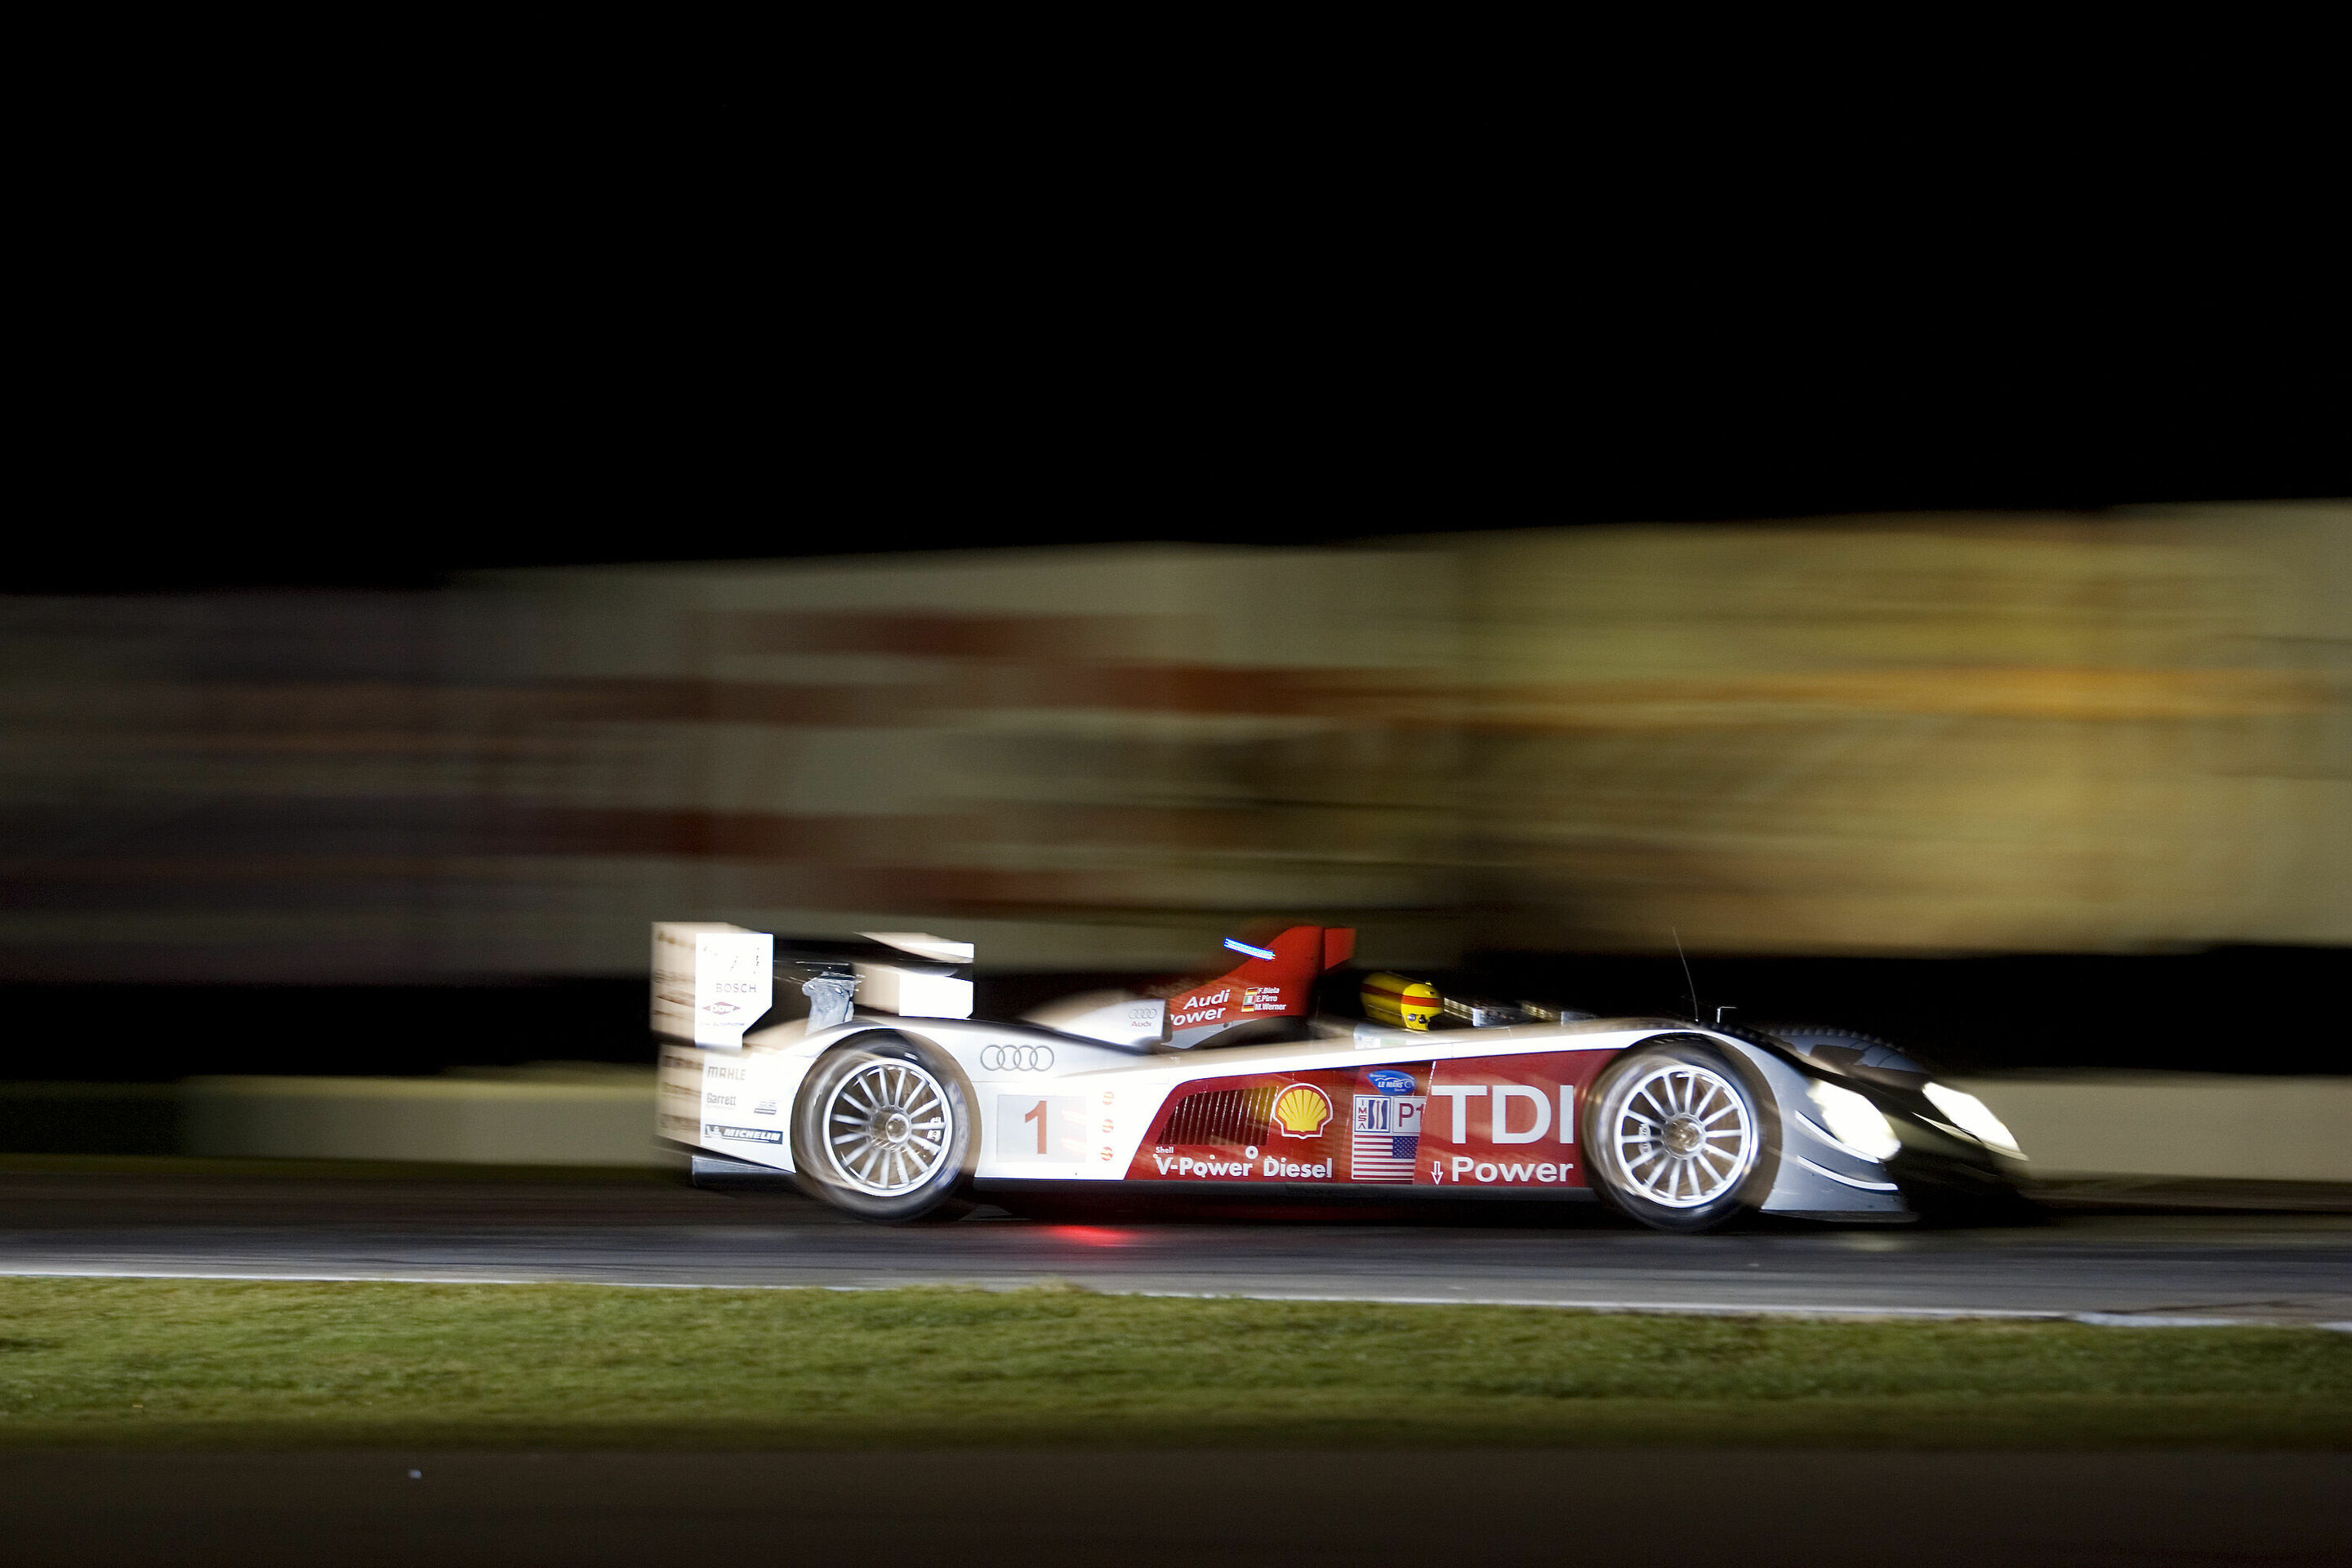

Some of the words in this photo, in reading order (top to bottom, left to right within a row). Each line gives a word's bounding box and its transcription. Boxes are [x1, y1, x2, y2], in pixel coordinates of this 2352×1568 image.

[715, 982, 756, 993] BOSCH
[1183, 989, 1231, 1010] Audi
[707, 1066, 746, 1080] MAHLE
[1386, 1081, 1404, 1089] MANS
[706, 1093, 737, 1106] Garrett
[1432, 1085, 1575, 1144] TDI
[723, 1127, 782, 1142] MICHELIN
[1024, 1100, 1048, 1155] 1
[1155, 1155, 1254, 1178] V-Power
[1263, 1156, 1333, 1178] Diesel
[1451, 1156, 1574, 1183] Power
